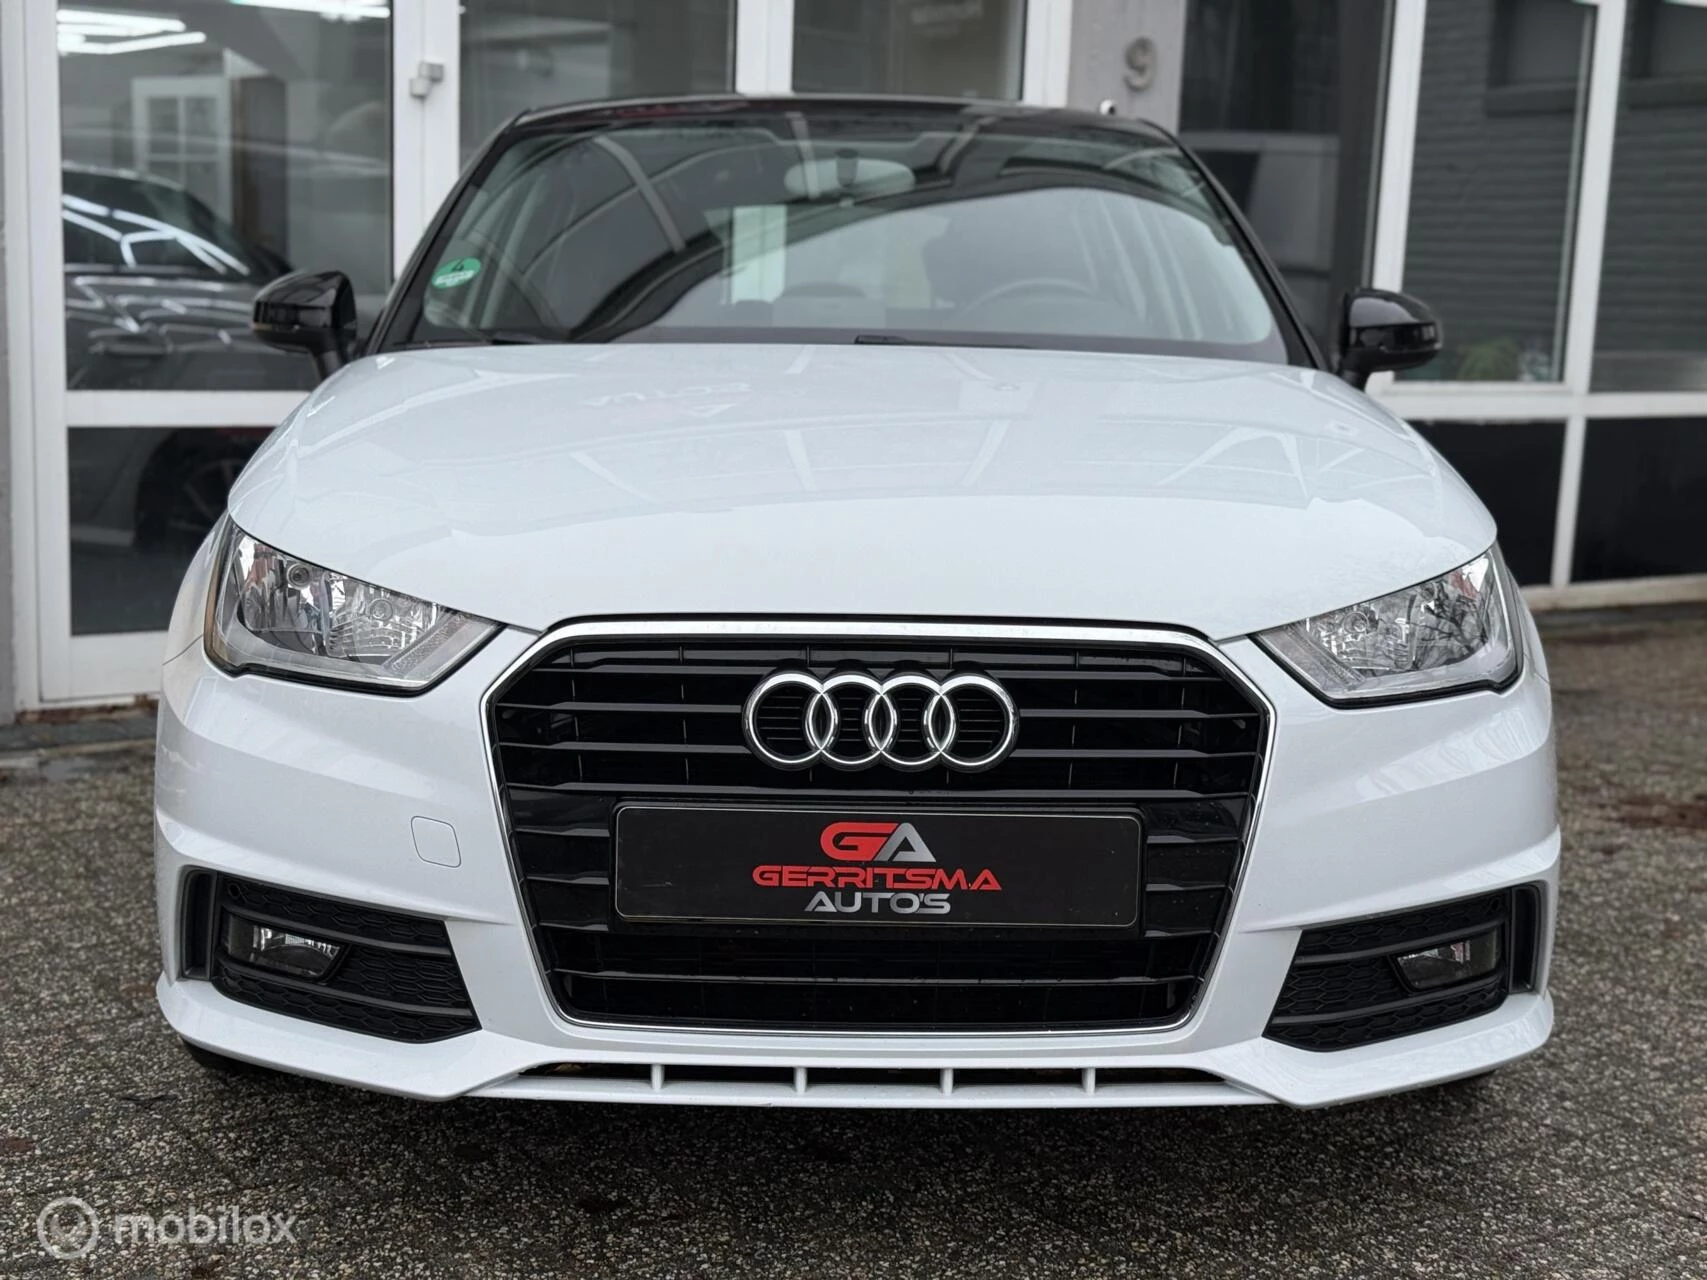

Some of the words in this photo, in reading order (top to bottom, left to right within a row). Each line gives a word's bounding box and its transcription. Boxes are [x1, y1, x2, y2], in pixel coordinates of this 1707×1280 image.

[1124, 36, 1156, 94] 9
[820, 822, 936, 862] GA
[752, 865, 1002, 890] GERRITSMA
[805, 891, 951, 915] AUTO'S
